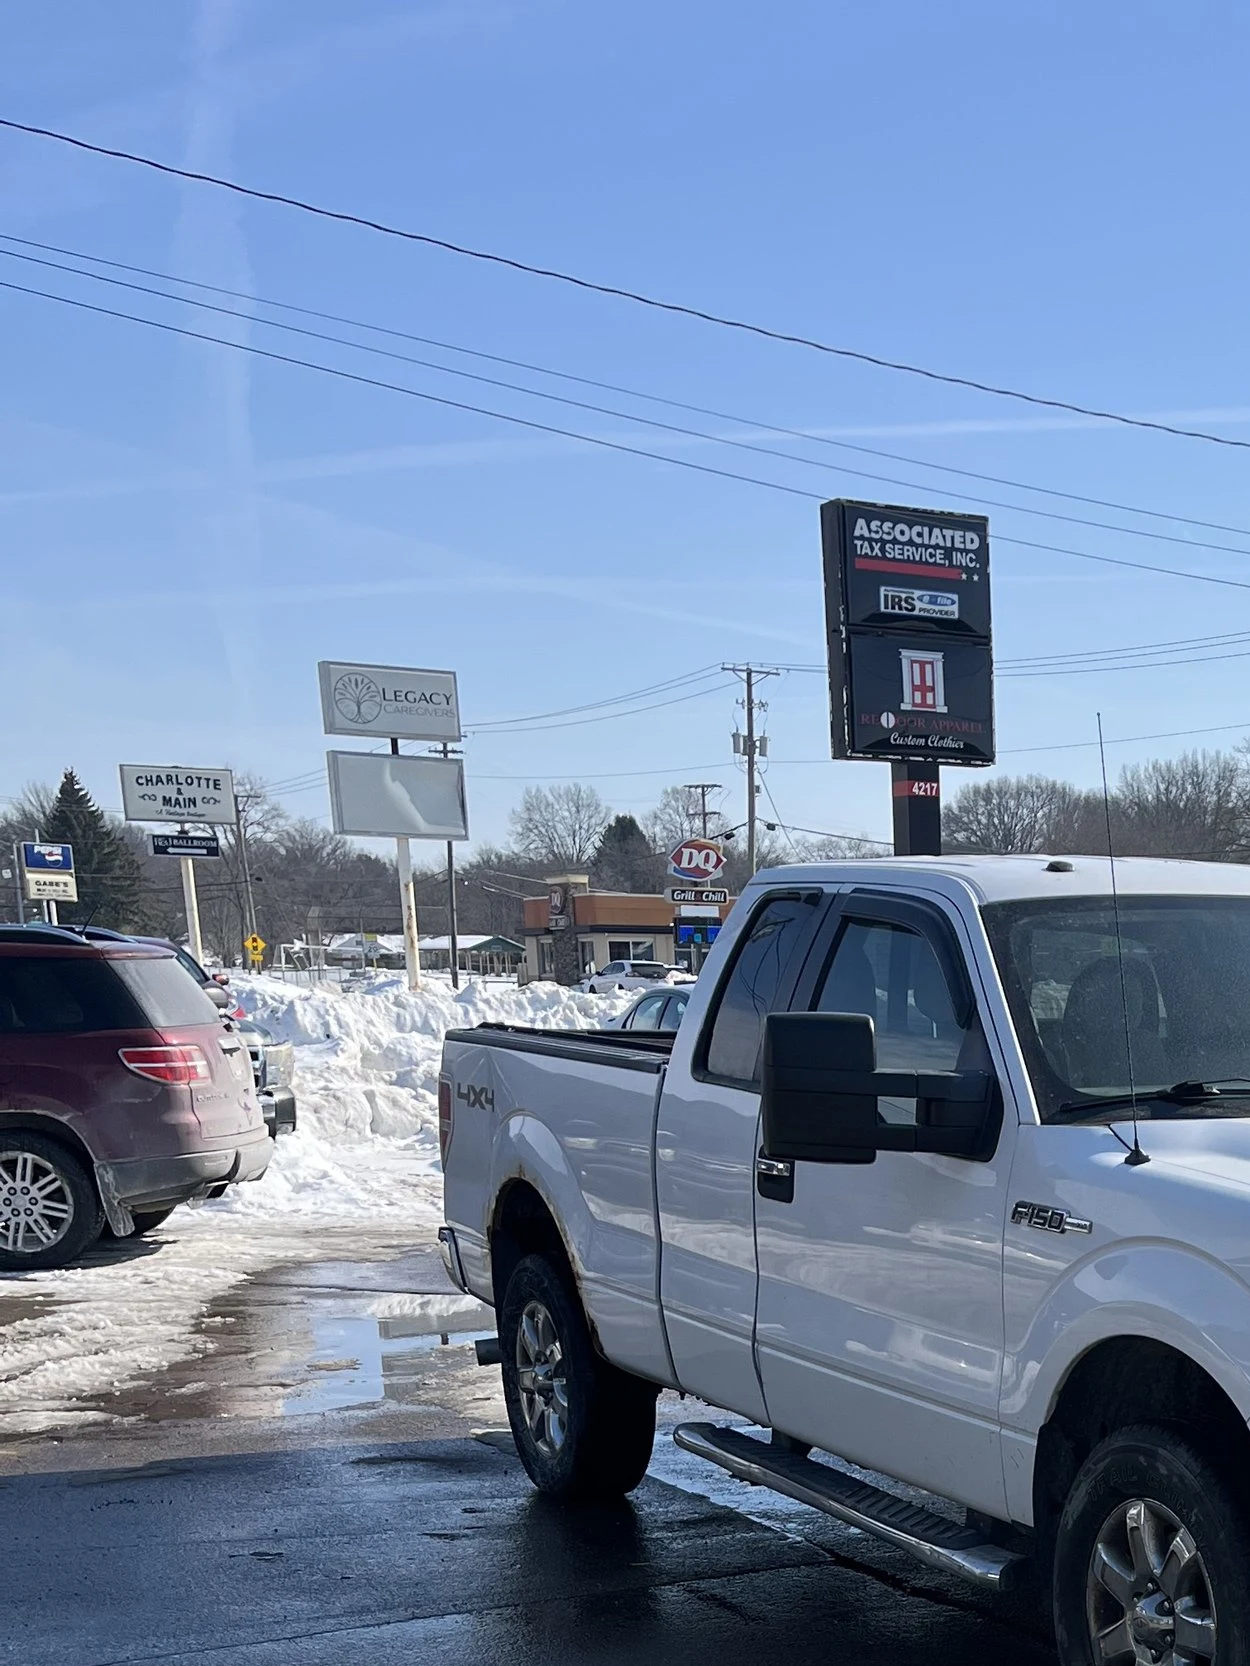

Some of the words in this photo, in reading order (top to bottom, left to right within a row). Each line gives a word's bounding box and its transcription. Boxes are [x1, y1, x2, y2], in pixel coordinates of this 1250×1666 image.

[853, 518, 980, 550] ASSOCIATED
[854, 540, 882, 557] TAX
[885, 544, 949, 567] SERVICE,
[952, 552, 980, 568] INC.
[883, 593, 916, 613] IRS
[918, 608, 956, 617] PROVIDER
[382, 688, 453, 706] LEGACY
[383, 703, 456, 719] CAREGIVERS
[929, 718, 987, 734] APPAREL
[890, 731, 926, 747] Custom
[927, 734, 964, 749] Clothier
[135, 774, 222, 791] CHARLOTTE
[912, 782, 938, 796] 4217
[176, 787, 184, 796] &
[162, 795, 197, 809] MAIN
[173, 838, 217, 847] BALLROOM
[681, 847, 717, 873] DQ
[673, 890, 695, 901] Grill
[702, 892, 725, 902] Chill
